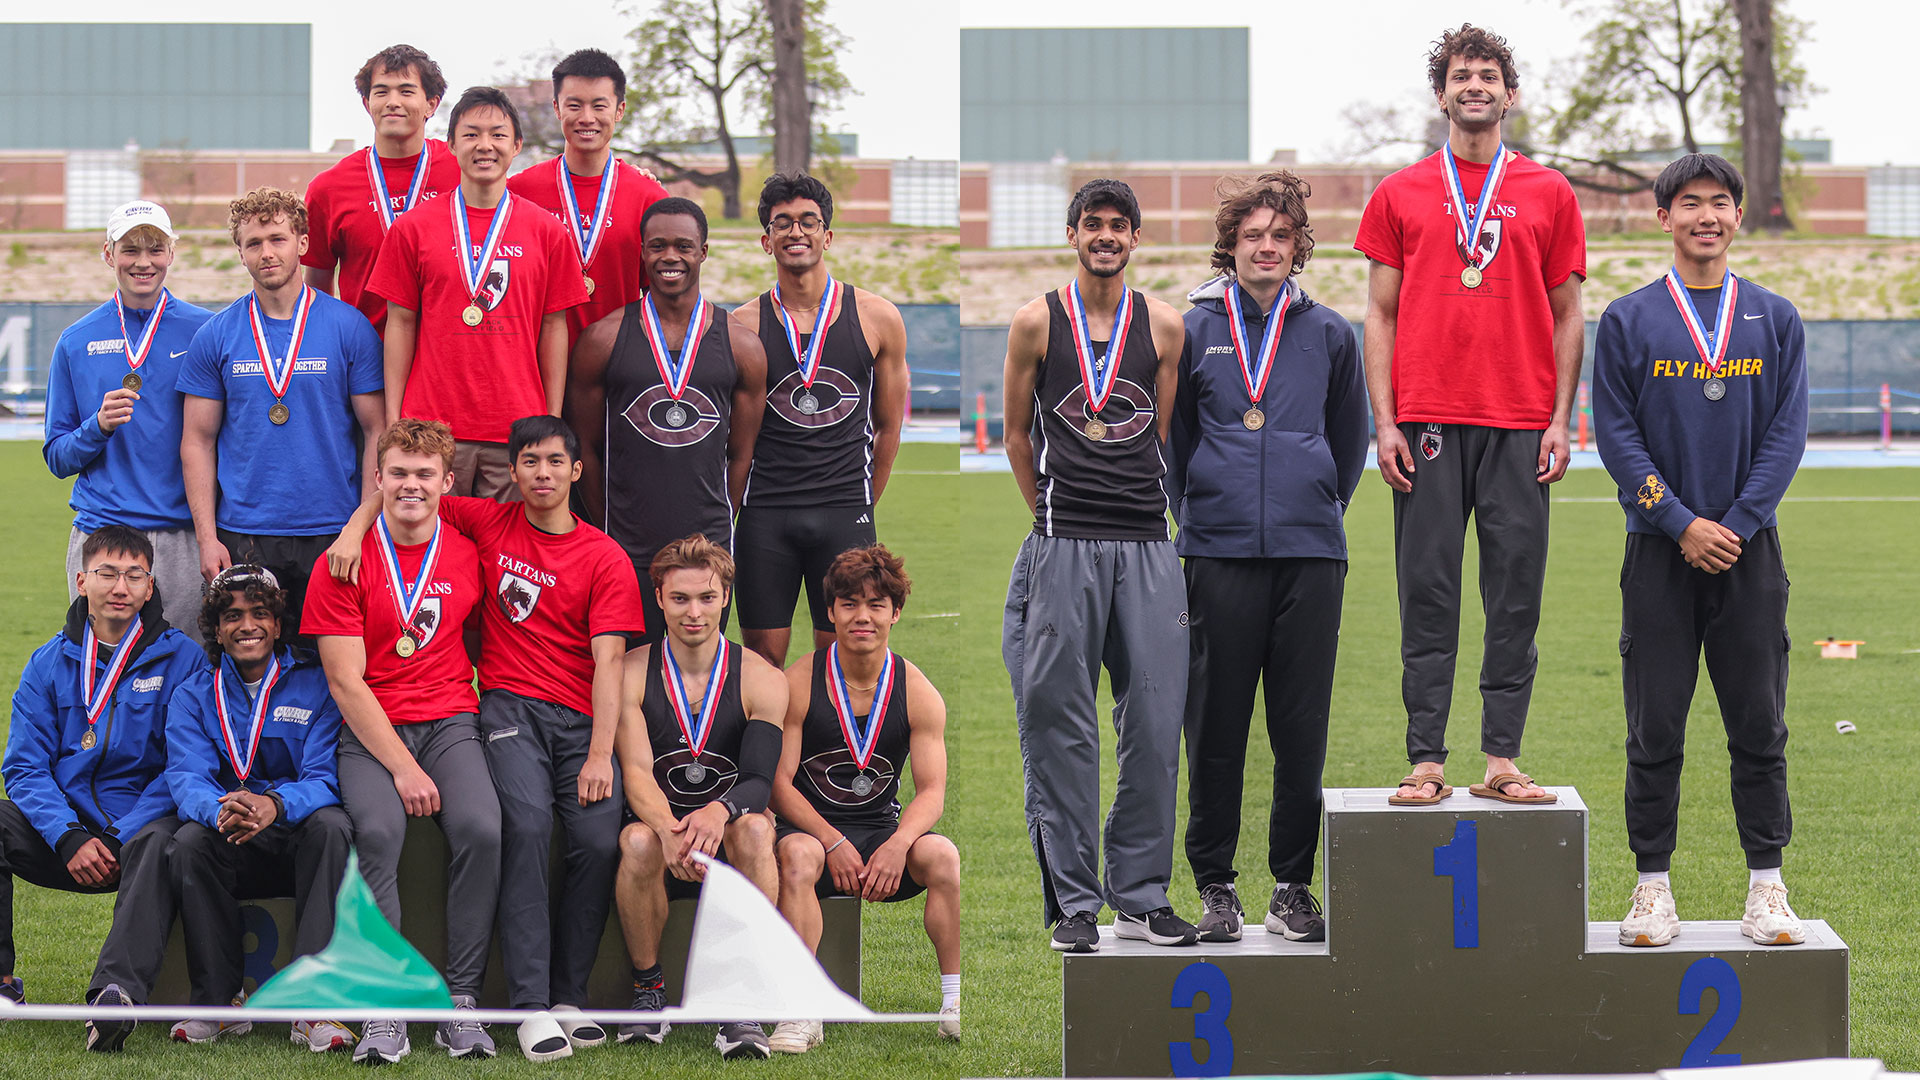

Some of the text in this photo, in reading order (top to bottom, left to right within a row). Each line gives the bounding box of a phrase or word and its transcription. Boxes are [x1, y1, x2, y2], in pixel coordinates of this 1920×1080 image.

[369, 191, 438, 213] TRTNS
[1443, 203, 1517, 218] TRANS
[451, 245, 524, 258] TRANS
[87, 339, 126, 352] CWRU
[295, 360, 327, 371] OGETHER
[1653, 358, 1763, 379] FLY HIGHER
[497, 553, 557, 588] TARTANS
[386, 582, 452, 597] RANS
[273, 706, 313, 721] CWRU
[1433, 820, 1479, 948] 1
[1169, 962, 1234, 1078] 3
[1678, 957, 1742, 1068] 2
